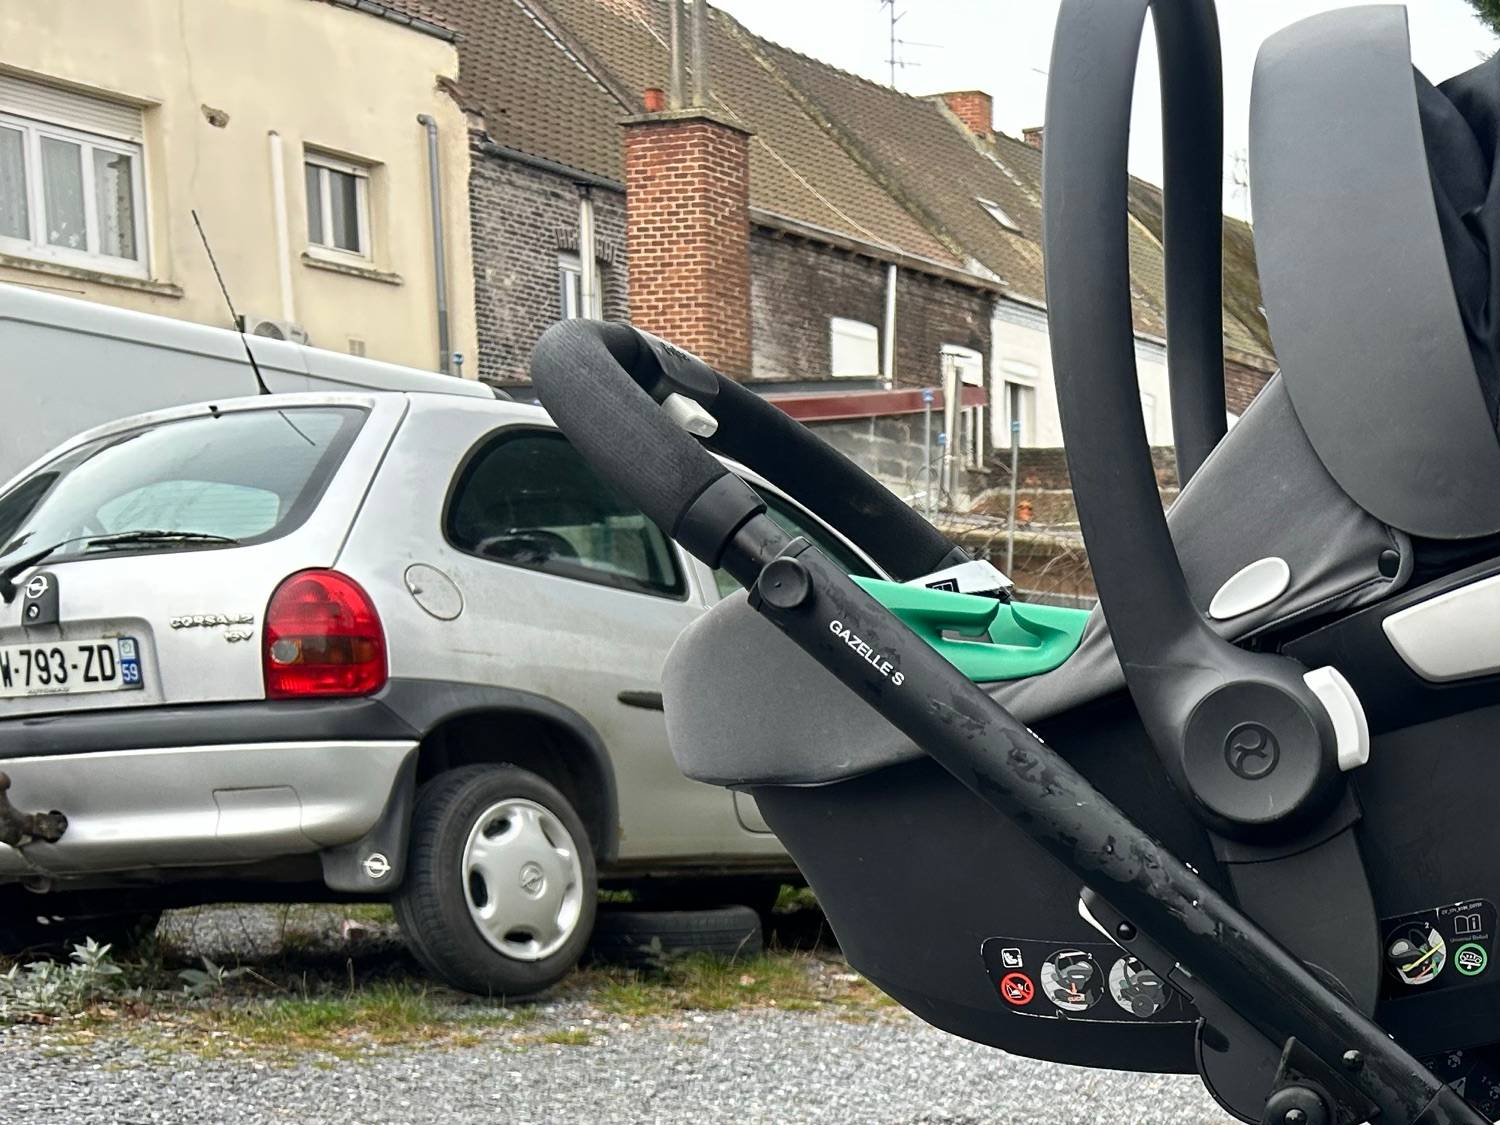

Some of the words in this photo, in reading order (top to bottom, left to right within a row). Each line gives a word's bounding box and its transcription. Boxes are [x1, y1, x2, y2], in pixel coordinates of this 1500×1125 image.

[122, 663, 138, 681] 59
[829, 620, 894, 677] GAZELLE
[891, 671, 905, 686] S
